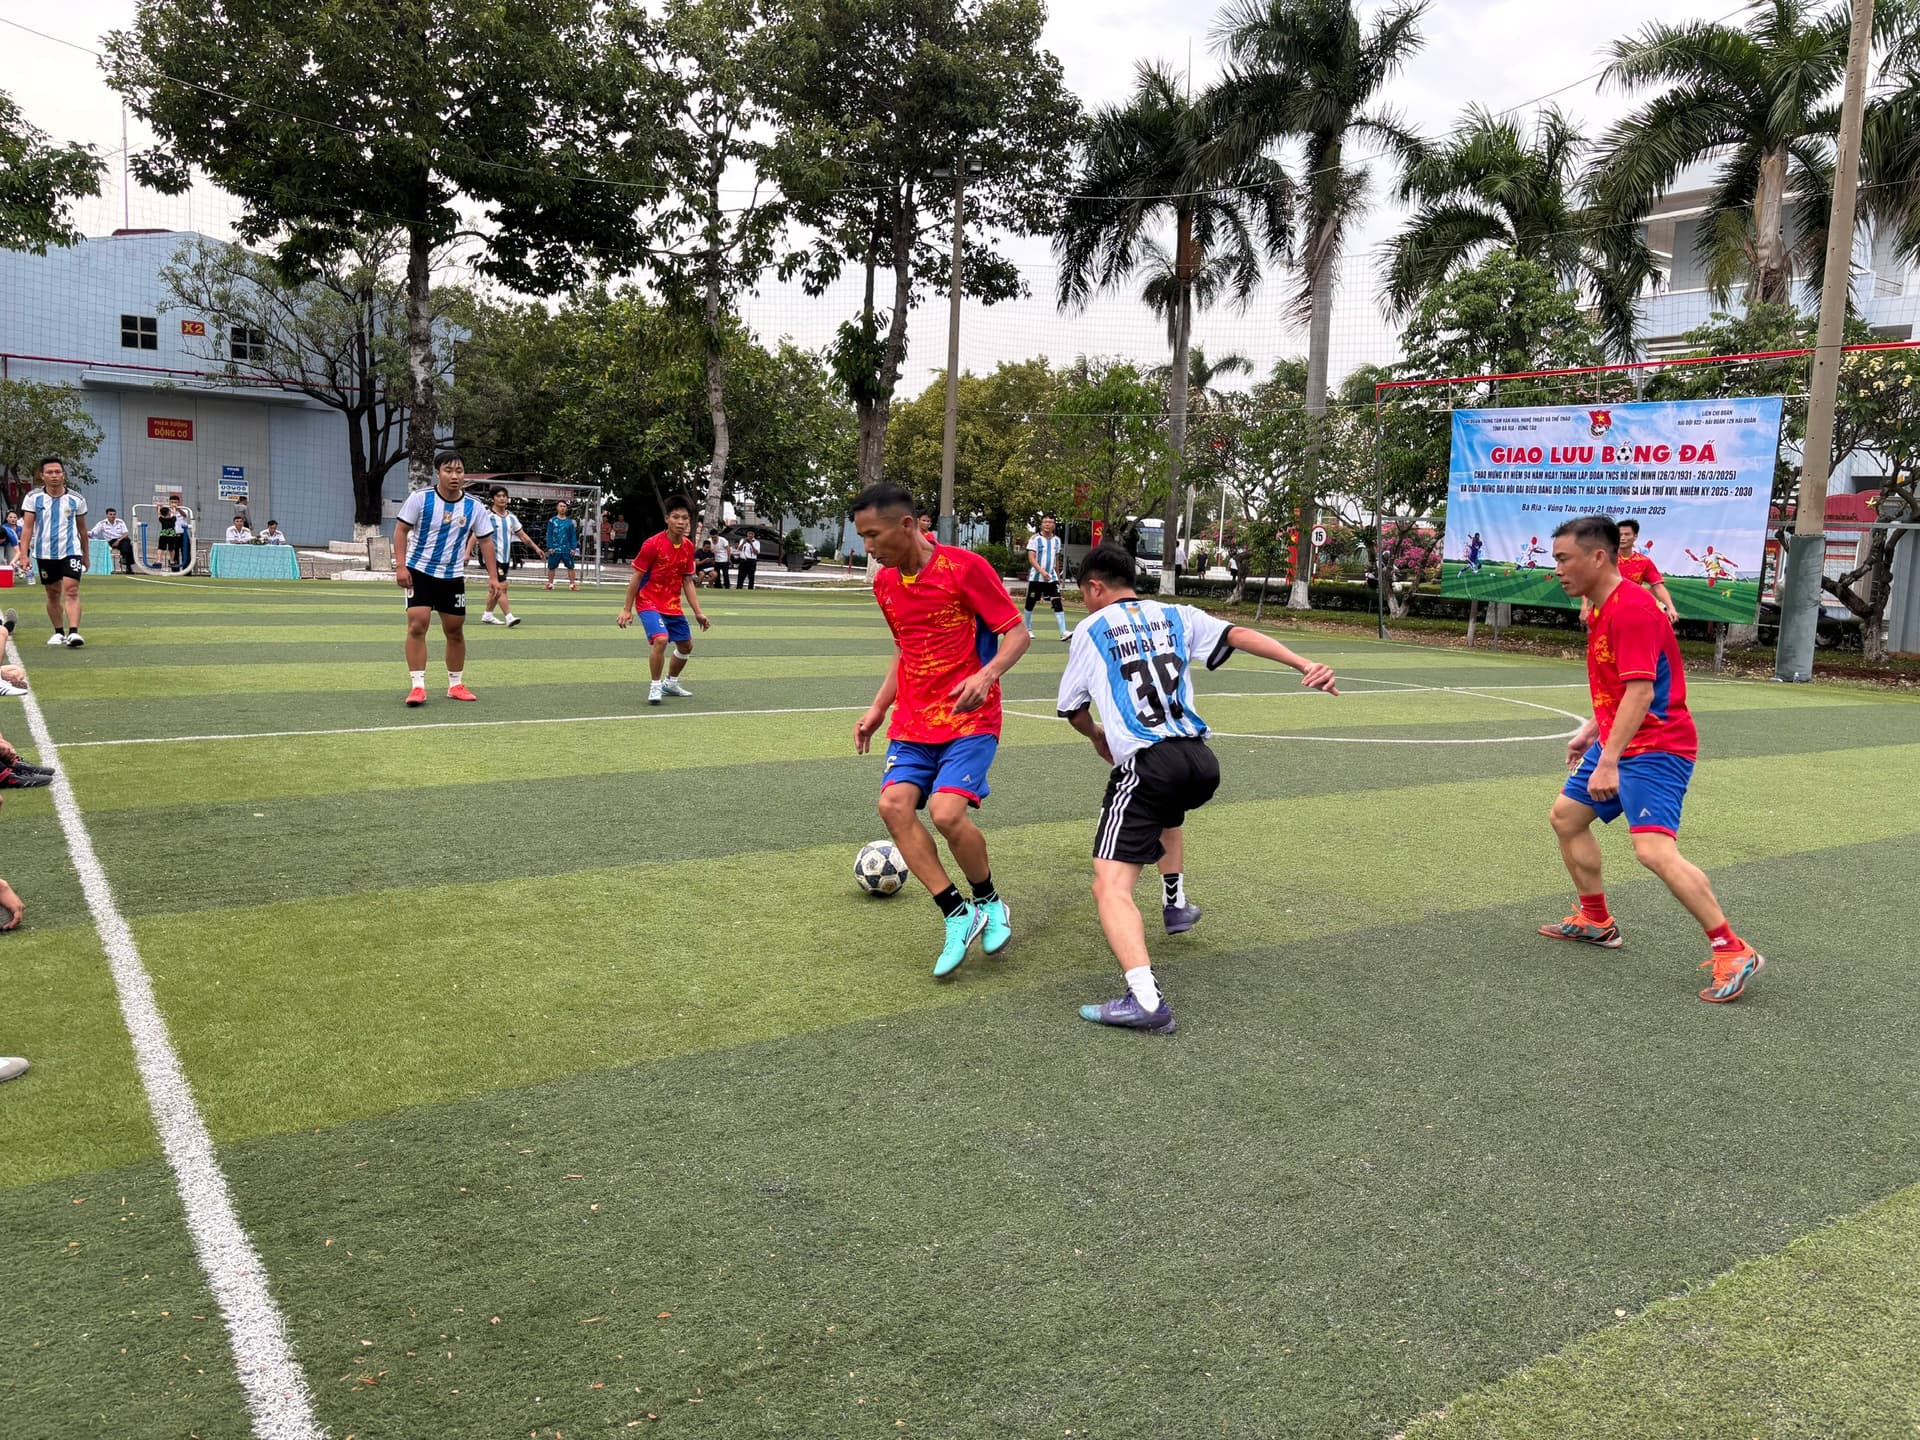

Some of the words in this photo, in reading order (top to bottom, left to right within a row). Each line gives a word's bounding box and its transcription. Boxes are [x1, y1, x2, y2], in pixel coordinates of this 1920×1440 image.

[183, 322, 203, 334] X2
[154, 427, 176, 438] ĐỘNG
[1491, 446, 1543, 464] GIAO
[1550, 446, 1595, 463] LƯU
[1524, 471, 1531, 480] 94
[1605, 470, 1619, 480] TNCS
[1640, 470, 1656, 480] MINH
[1578, 486, 1585, 494] TY
[1632, 486, 1639, 495] SA
[1711, 486, 1729, 496] 2025
[1735, 487, 1753, 496] 2030
[1596, 505, 1604, 513] 21
[1606, 505, 1625, 514] tháng
[1625, 506, 1631, 514] 3
[1648, 506, 1666, 515] 2025
[1315, 531, 1323, 541] 15
[69, 558, 81, 569] 86
[1104, 625, 1130, 639] TRUNG
